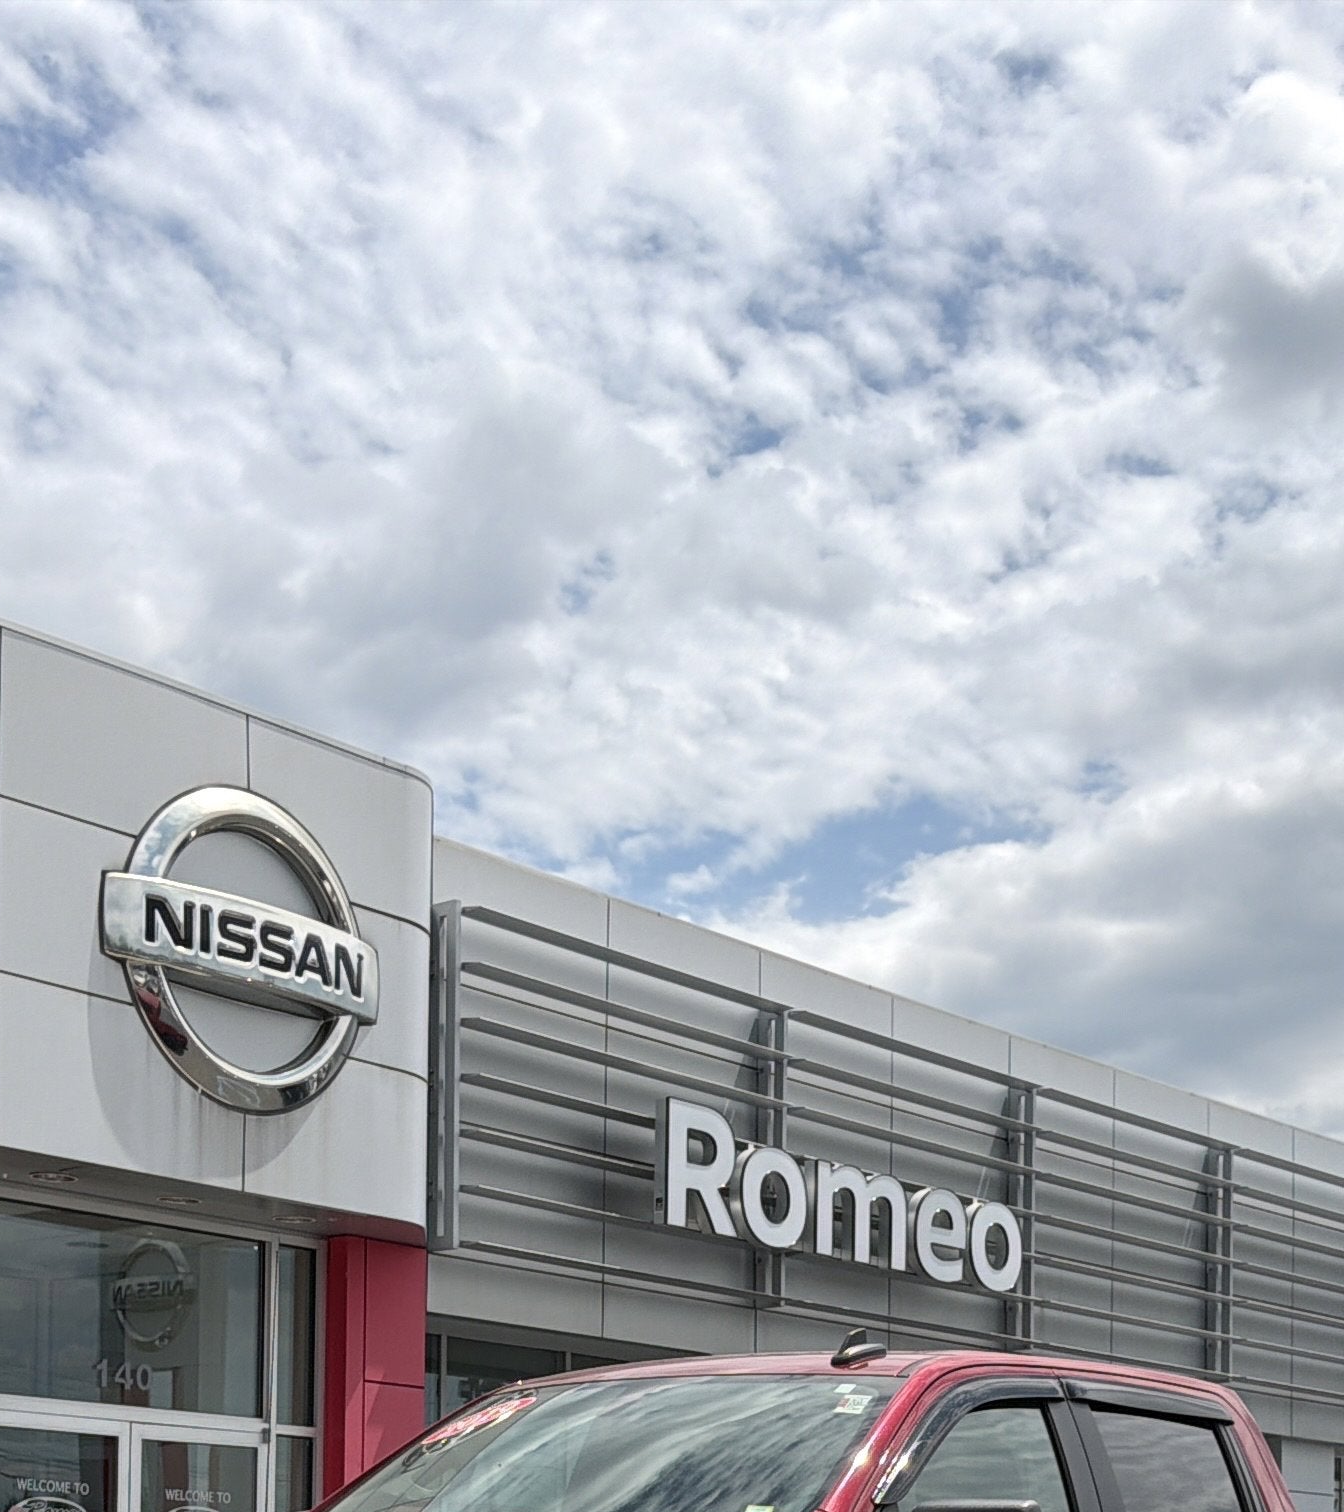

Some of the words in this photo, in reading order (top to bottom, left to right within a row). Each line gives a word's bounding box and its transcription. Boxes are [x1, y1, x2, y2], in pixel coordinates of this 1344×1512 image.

[143, 893, 365, 1000] NISSAN
[666, 1096, 1022, 1292] Romeo
[96, 1358, 152, 1391] 140
[17, 1478, 71, 1494] WELCOME
[73, 1482, 90, 1495] TO
[165, 1488, 215, 1503] WELCOME
[218, 1491, 231, 1504] TO
